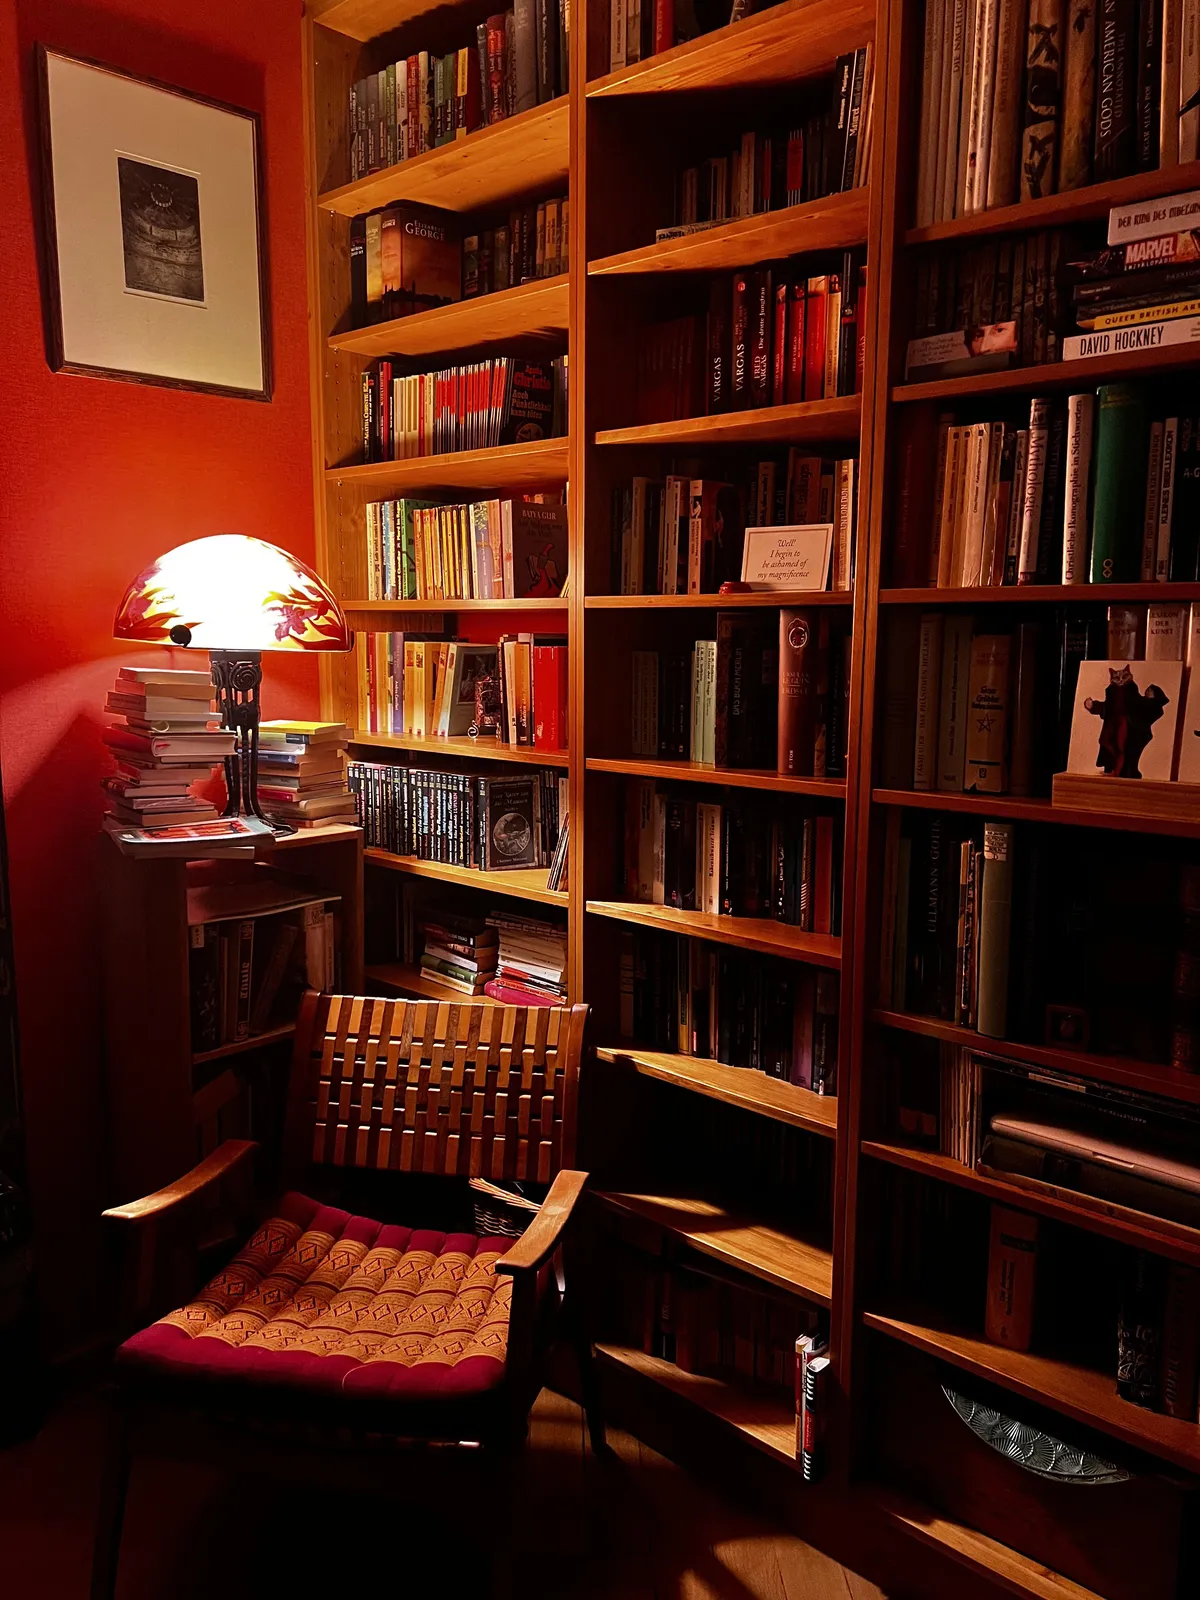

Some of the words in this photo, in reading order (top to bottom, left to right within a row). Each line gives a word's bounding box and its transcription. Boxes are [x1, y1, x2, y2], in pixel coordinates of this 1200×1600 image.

[1102, 20, 1115, 93] AMERICAN
[841, 65, 849, 92] Maigret
[1114, 56, 1125, 118] ANNOTATED
[837, 98, 846, 129] Simenon
[849, 106, 860, 137] Maigret
[1100, 97, 1113, 137] GODS
[1143, 131, 1151, 161] EDGAR
[405, 222, 445, 242] GEORGE
[1118, 216, 1132, 228] DER
[1134, 213, 1150, 225] RING
[1152, 209, 1166, 222] DES
[1126, 236, 1175, 264] MARVEL
[1104, 314, 1135, 325] QUEER
[1139, 307, 1179, 319] BRITISH
[1182, 303, 1200, 312] ART
[1080, 335, 1109, 356] DAVID
[1114, 326, 1164, 350] HOCKNEY
[514, 371, 551, 391] Christie
[713, 357, 722, 402] VARGAS
[736, 344, 745, 391] VARGAS
[760, 354, 768, 388] VARGAS
[1071, 400, 1083, 455] Stichworten
[1072, 456, 1081, 466] in
[1162, 430, 1173, 488] BIBELLEXIKON
[1024, 435, 1045, 517] Mythologie
[1067, 467, 1082, 529] Ikonographie
[1161, 489, 1170, 524] KLEINES
[522, 509, 541, 519] BATYA
[542, 511, 557, 520] GUR
[762, 560, 769, 568] be
[770, 560, 799, 568] ashamed
[800, 559, 809, 569] of
[770, 550, 774, 558] I
[774, 550, 793, 559] begin
[1065, 531, 1075, 580] Christliche
[757, 572, 768, 580] my
[768, 570, 810, 580] magnificence
[734, 647, 743, 677] MERLIN
[733, 677, 741, 698] BUCH
[918, 669, 928, 712] PHÄNOMEN
[732, 699, 740, 715] DAS
[929, 819, 941, 860] GOTIK
[927, 867, 940, 933] ULLMANN
